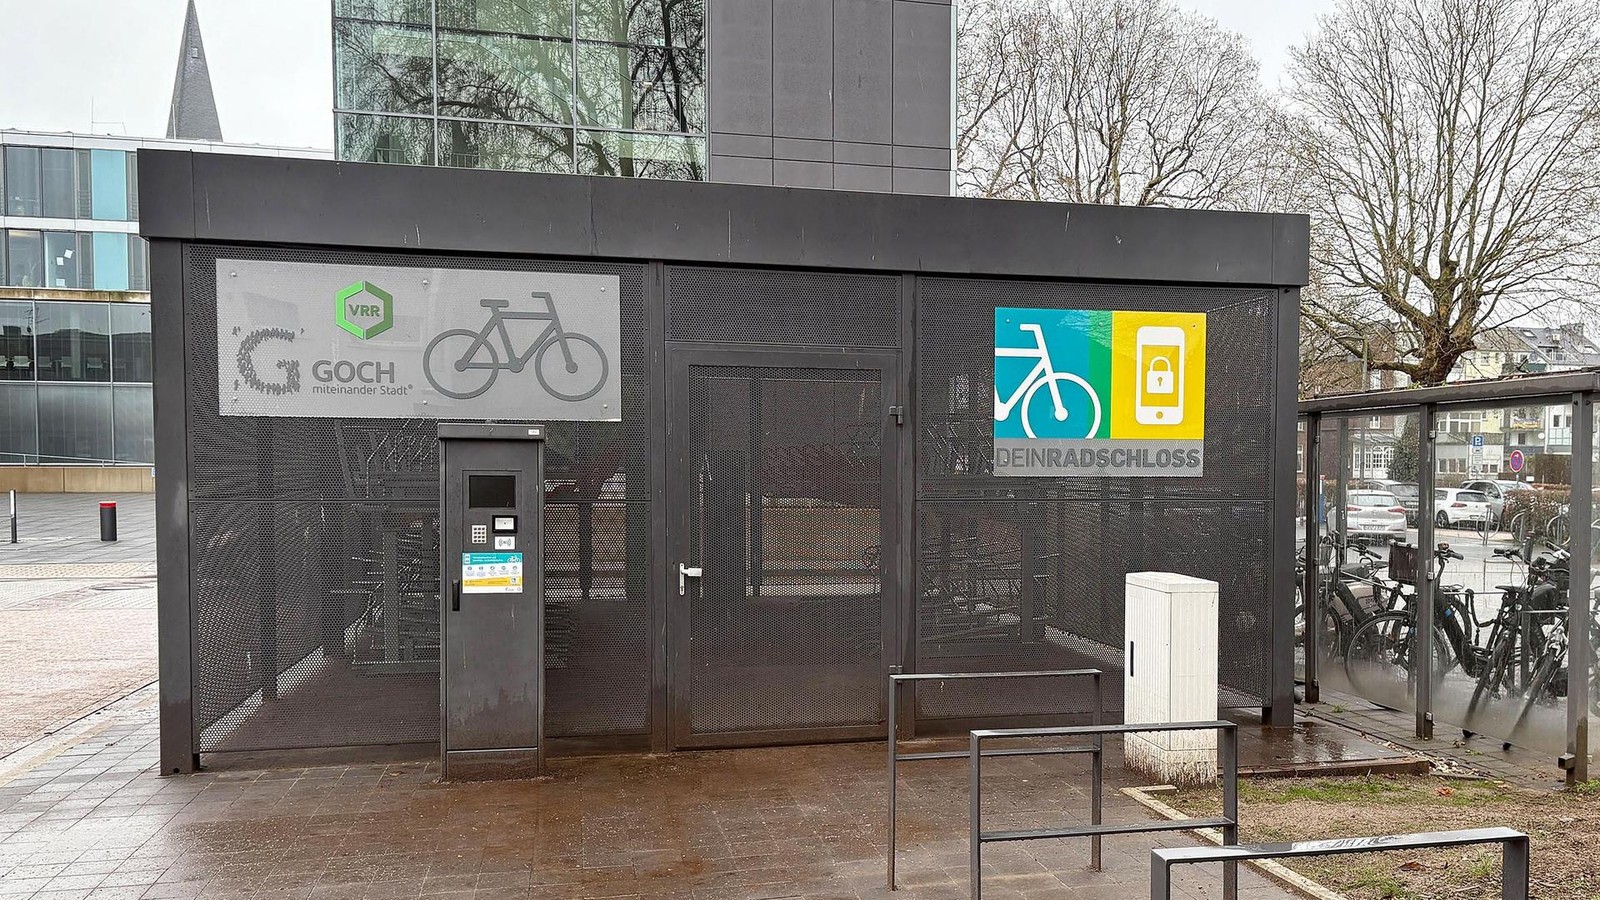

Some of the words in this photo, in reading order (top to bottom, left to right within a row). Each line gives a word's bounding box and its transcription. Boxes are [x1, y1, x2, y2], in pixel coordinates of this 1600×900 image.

[348, 304, 380, 317] VRR
[312, 360, 395, 383] GOCH
[312, 384, 377, 395] miteinander
[996, 448, 1201, 468] DEINRADSCHLOSS
